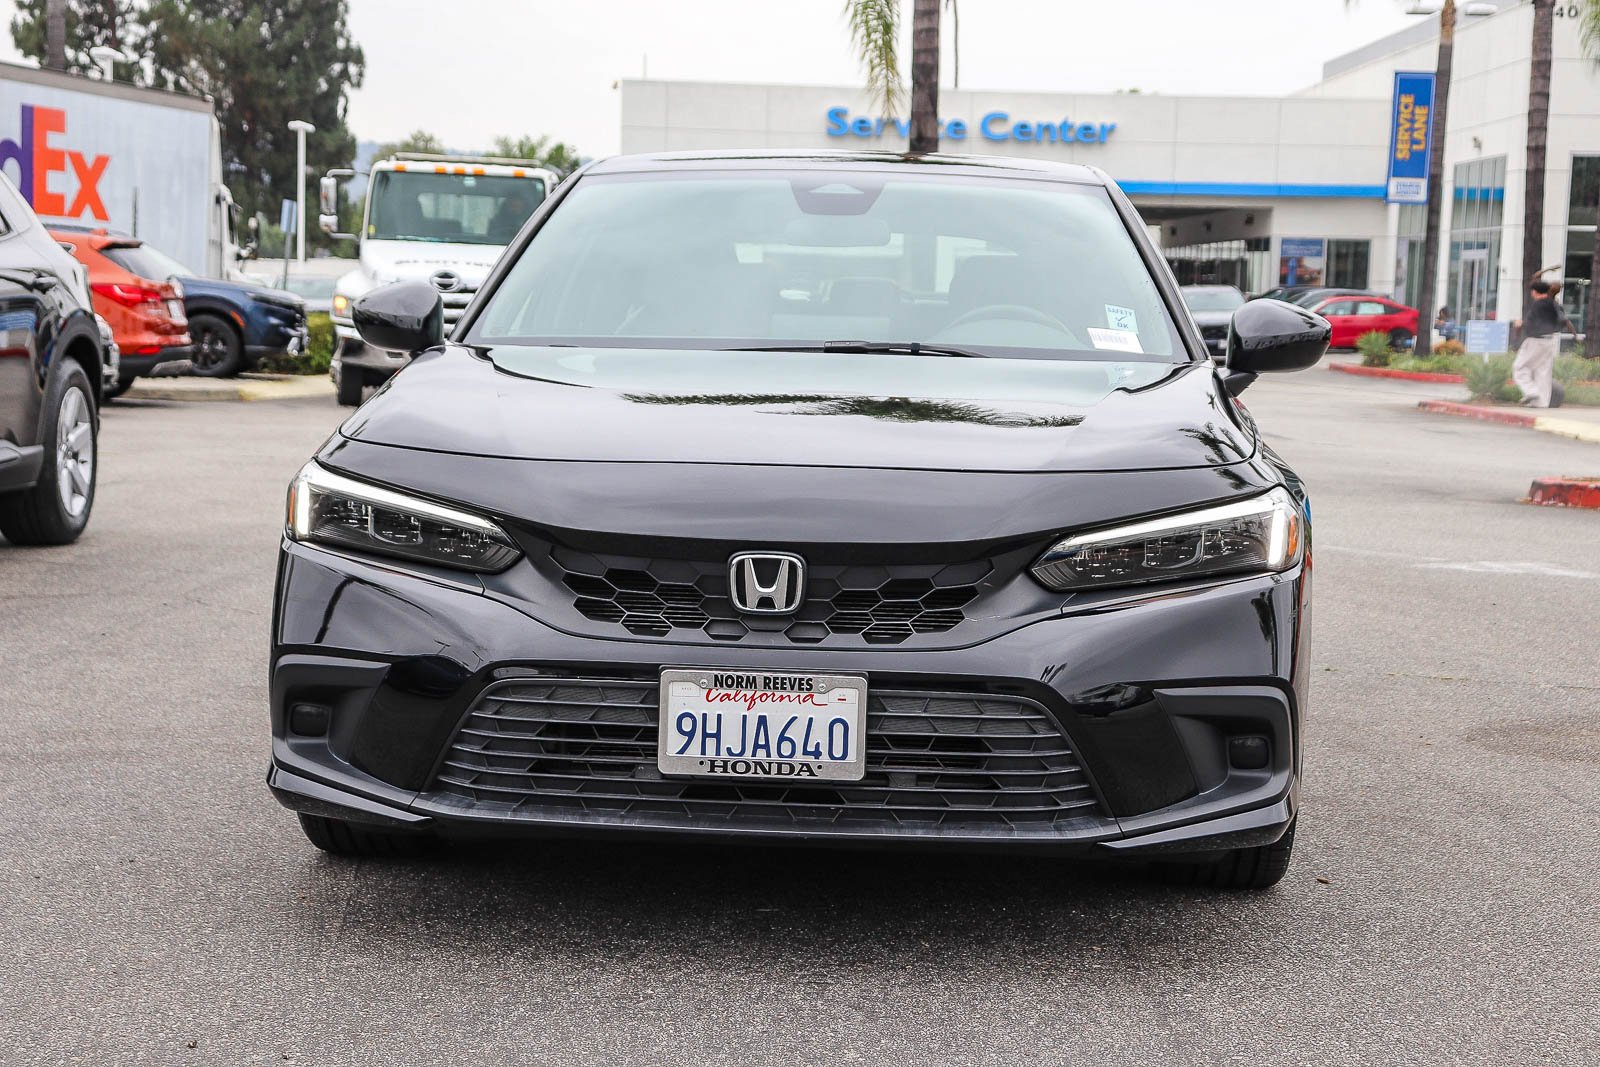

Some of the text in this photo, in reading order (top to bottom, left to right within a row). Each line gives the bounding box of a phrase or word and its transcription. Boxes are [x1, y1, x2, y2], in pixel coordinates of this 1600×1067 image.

[826, 106, 1116, 143] Serve Center
[1396, 94, 1414, 161] SERVICE
[1411, 105, 1428, 151] LANE
[1107, 307, 1133, 317] SAFETY
[713, 675, 814, 692] NORM REEVES
[705, 689, 828, 711] California
[675, 711, 850, 761] 9HJA640
[707, 759, 818, 777] HONDA
